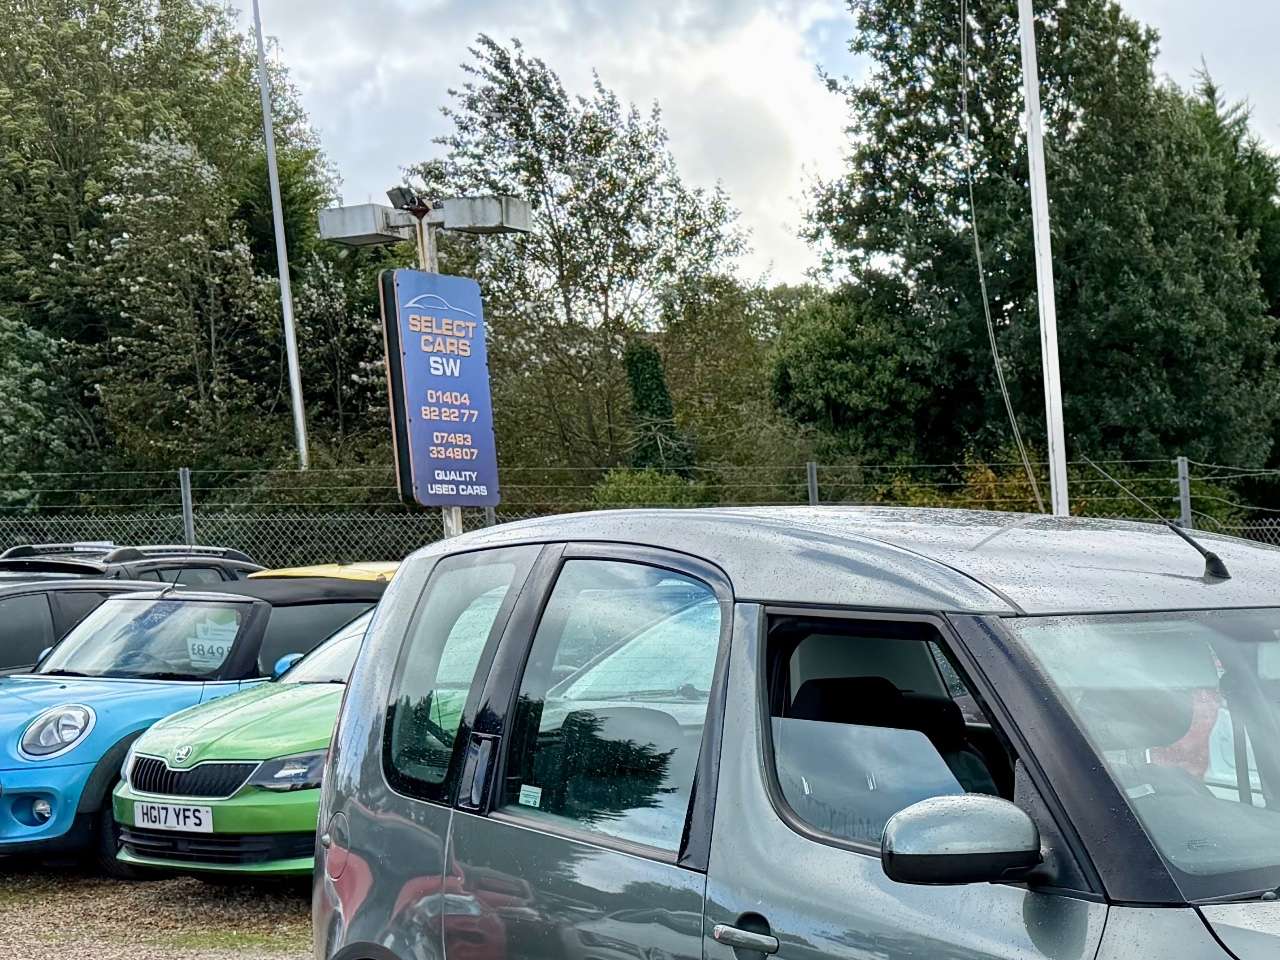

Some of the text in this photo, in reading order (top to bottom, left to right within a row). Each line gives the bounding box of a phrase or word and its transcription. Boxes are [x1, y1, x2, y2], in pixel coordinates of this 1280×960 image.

[408, 314, 477, 338] SELECT
[421, 335, 471, 357] CARS
[429, 355, 461, 377] SW
[427, 389, 470, 406] 01404
[429, 446, 478, 460] 334807
[434, 469, 478, 482] QUALITY
[427, 483, 488, 496] USED CARS
[141, 804, 202, 827] HG17 YFS
